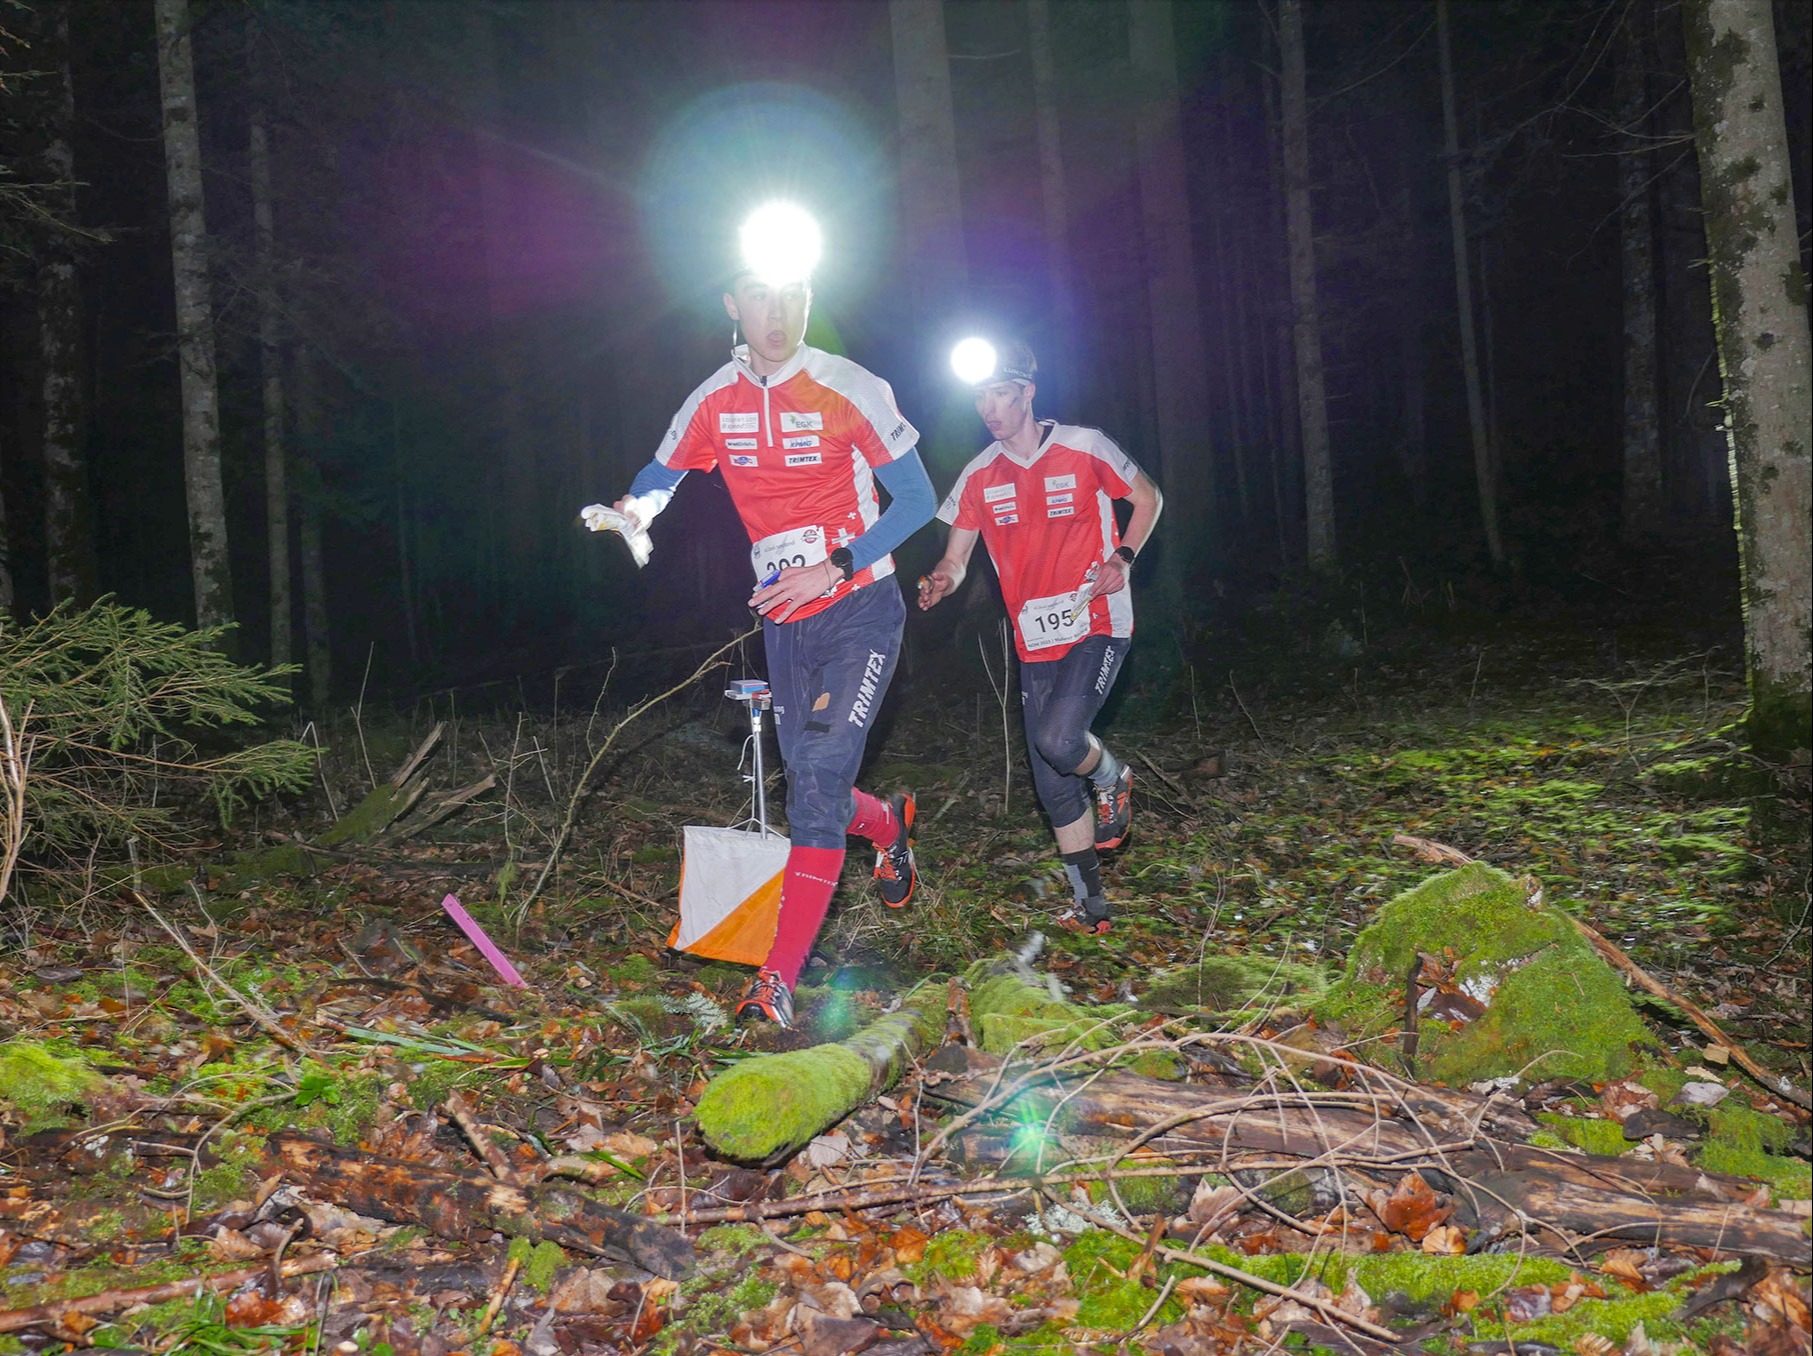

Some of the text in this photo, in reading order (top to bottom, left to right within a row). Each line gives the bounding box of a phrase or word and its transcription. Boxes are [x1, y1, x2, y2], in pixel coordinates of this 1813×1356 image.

[795, 420, 813, 429] EGK
[789, 440, 812, 448] KPMG
[788, 455, 818, 464] TRIMTEX
[1035, 608, 1074, 633] 195
[1094, 645, 1115, 695] TRIMTEX
[848, 648, 886, 728] TRIMTEX
